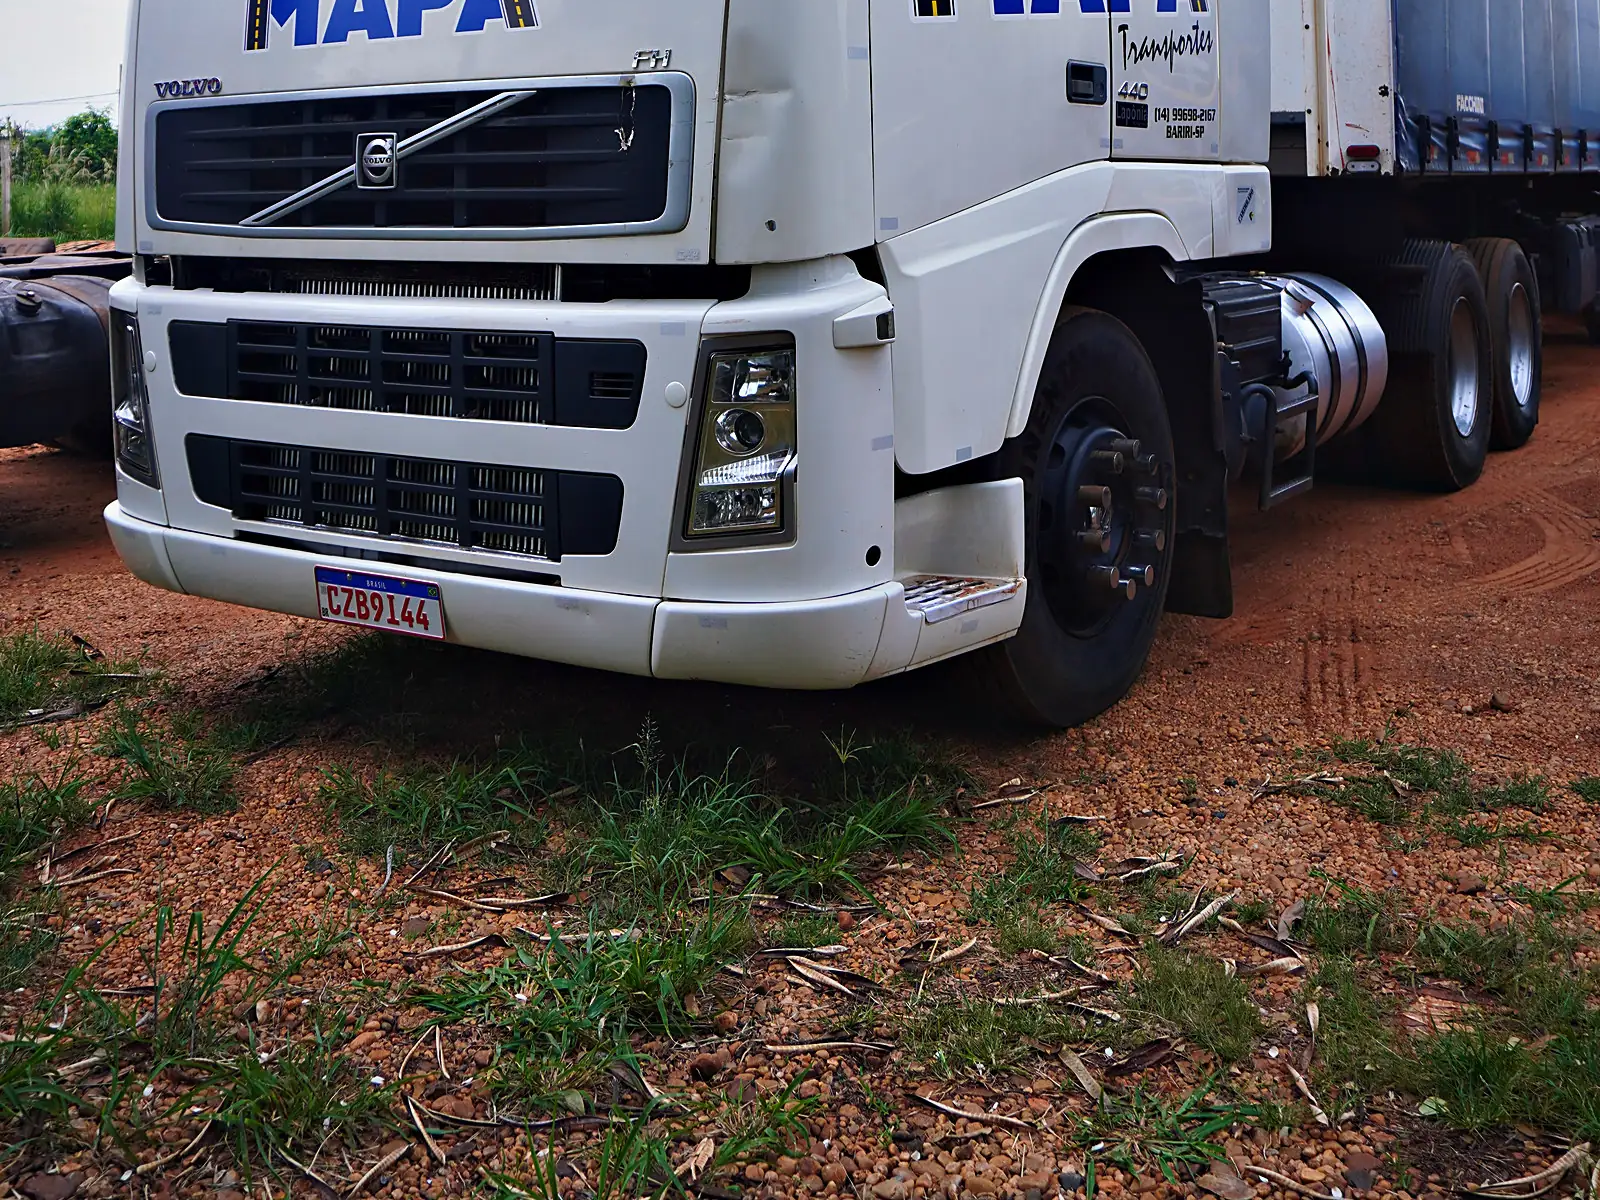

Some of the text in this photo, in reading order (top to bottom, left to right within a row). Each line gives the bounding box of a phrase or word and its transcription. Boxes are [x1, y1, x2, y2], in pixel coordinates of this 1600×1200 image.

[1117, 20, 1214, 73] Transportes
[632, 48, 672, 69] FH
[153, 76, 222, 98] VOLVO
[1117, 80, 1149, 100] 440
[1154, 107, 1216, 122] (14) 99698-2167
[1166, 125, 1205, 139] BARIRI-SP
[363, 156, 393, 164] VOLVO
[366, 580, 387, 590] BRASIL
